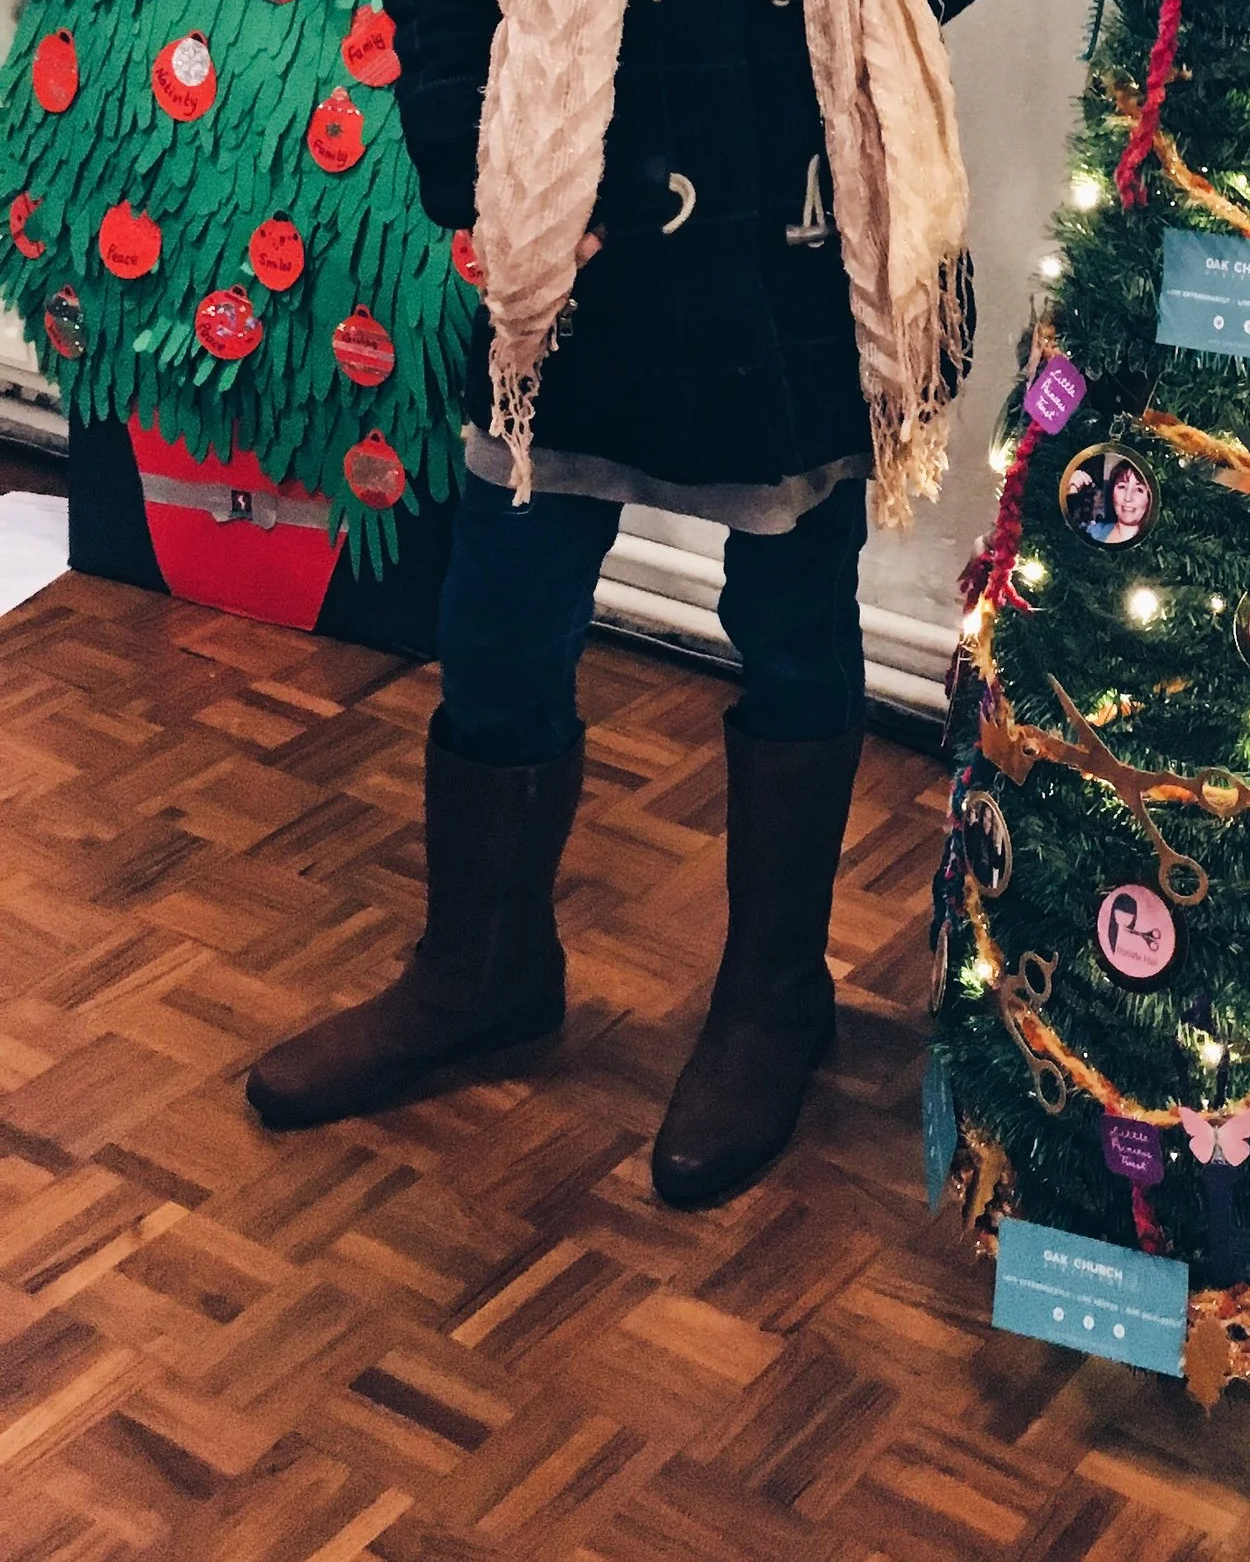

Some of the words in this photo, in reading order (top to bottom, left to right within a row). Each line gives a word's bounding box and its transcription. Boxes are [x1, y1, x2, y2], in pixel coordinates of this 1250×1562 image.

[347, 32, 386, 63] Family
[155, 67, 198, 117] Nativity
[313, 138, 348, 168] Family
[106, 243, 139, 266] Peace
[1205, 257, 1230, 271] OAK
[1049, 369, 1076, 398] Little
[1043, 1249, 1068, 1267] OAK
[1073, 1257, 1123, 1281] CHURCH
